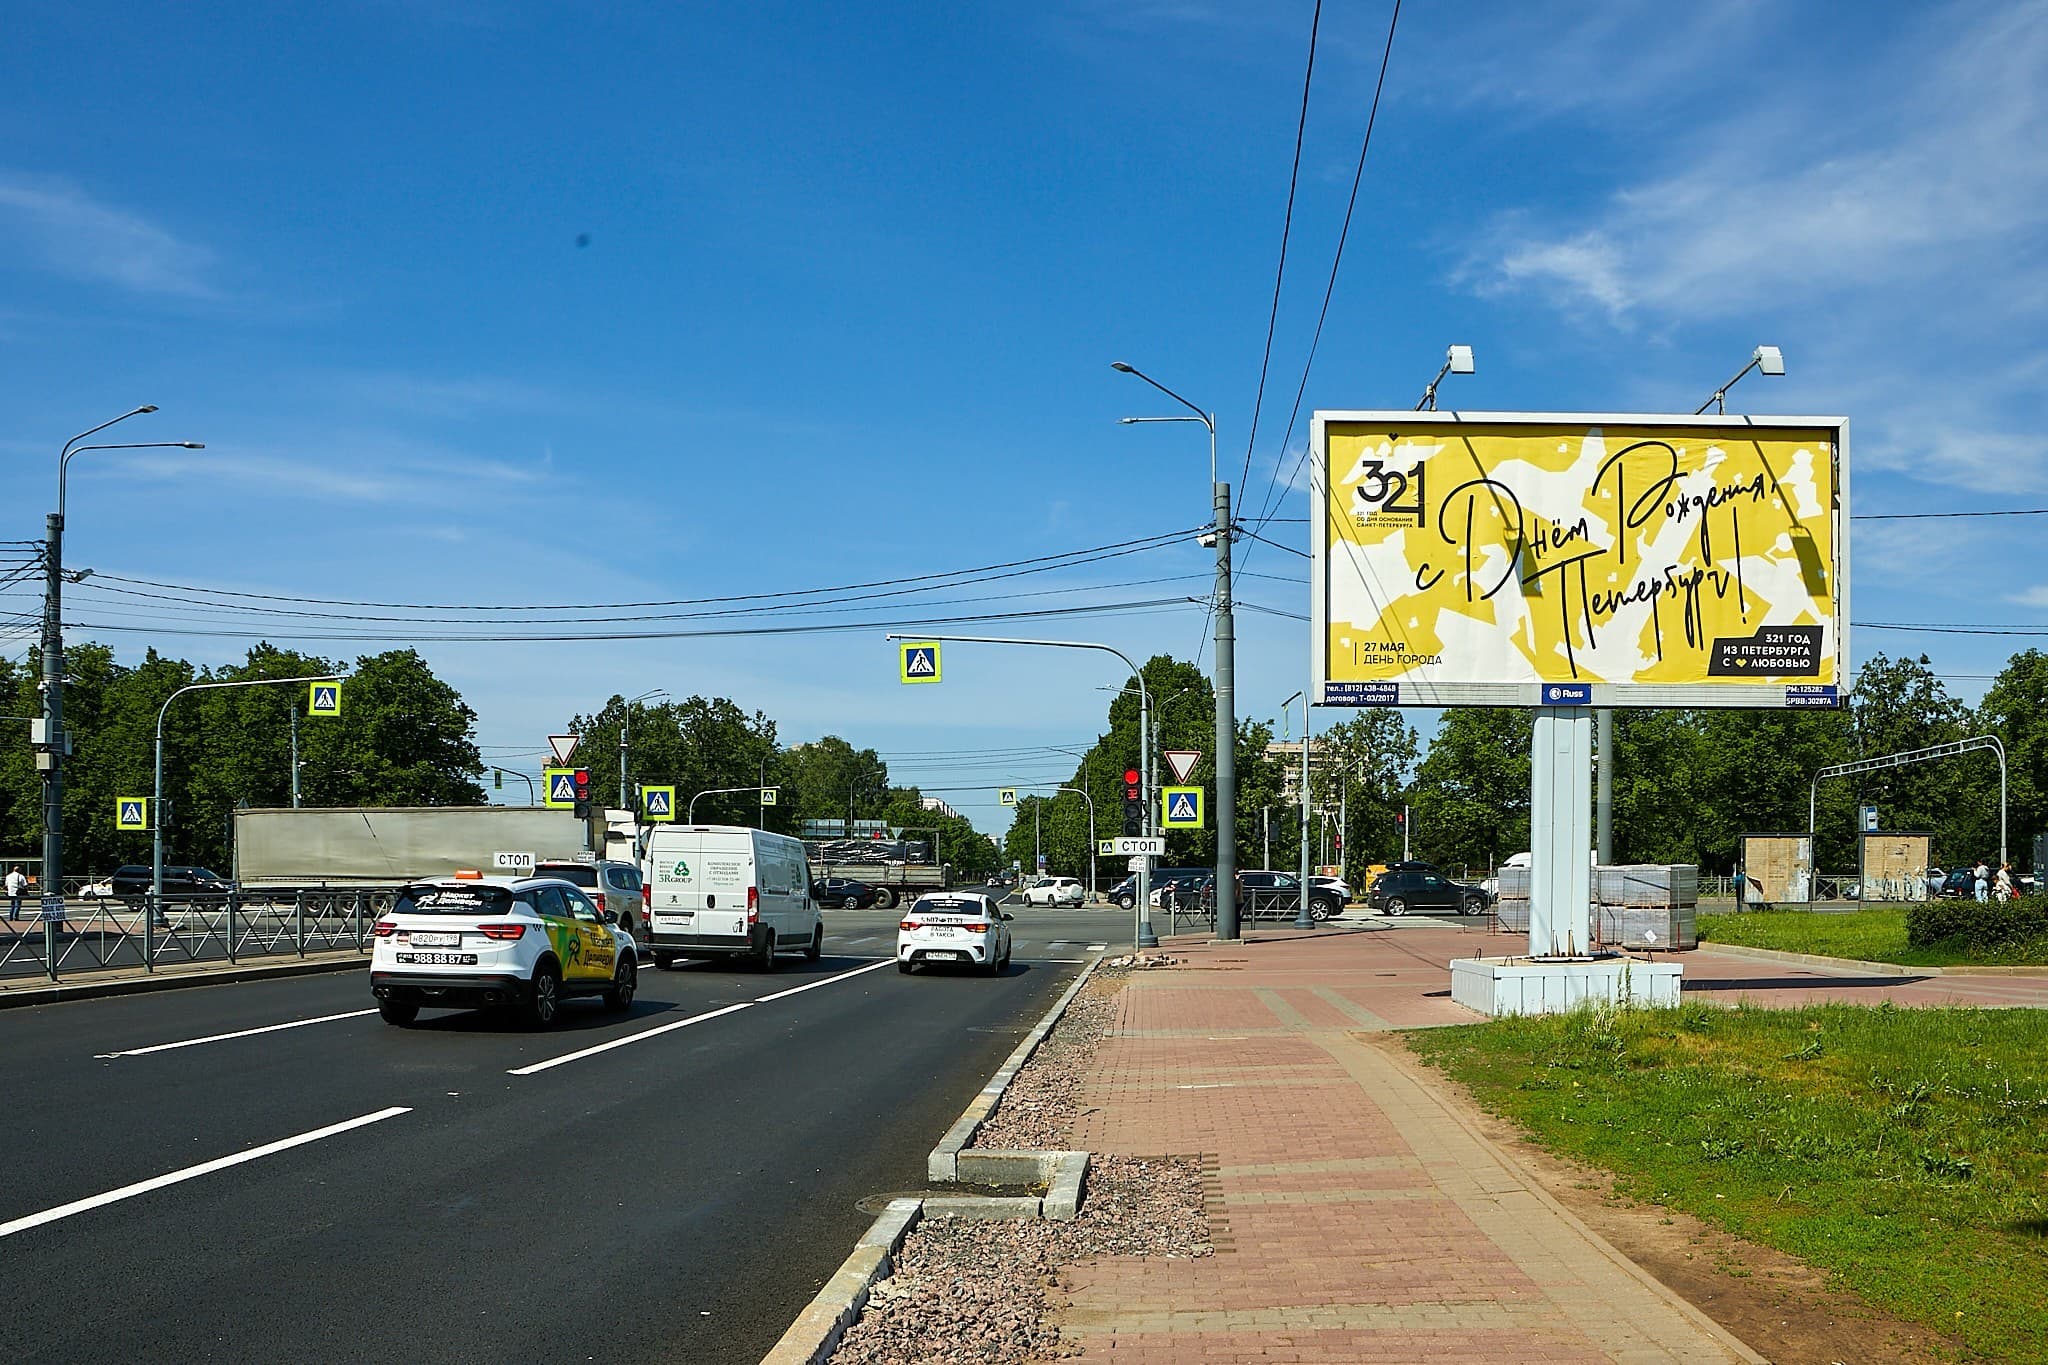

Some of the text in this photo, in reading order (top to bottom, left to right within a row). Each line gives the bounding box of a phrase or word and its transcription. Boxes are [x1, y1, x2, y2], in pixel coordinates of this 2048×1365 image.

[1357, 460, 1425, 528] 321
[1439, 479, 1589, 602] Днём
[1765, 634, 1811, 645] 321 ГОД
[1364, 643, 1405, 652] 27 МАЯ
[1723, 646, 1811, 656] ИЗ ПЕТЕРБУРГА
[1364, 655, 1442, 665] ДЕНЬ ГОРОДА
[1722, 658, 1811, 668] С ЛЮБОВЬЮ
[1562, 689, 1584, 698] Russ
[1121, 840, 1157, 852] СТОП
[499, 854, 530, 866] СТОП
[413, 953, 433, 964] 988
[433, 954, 448, 964] 88
[448, 954, 462, 964] 87
